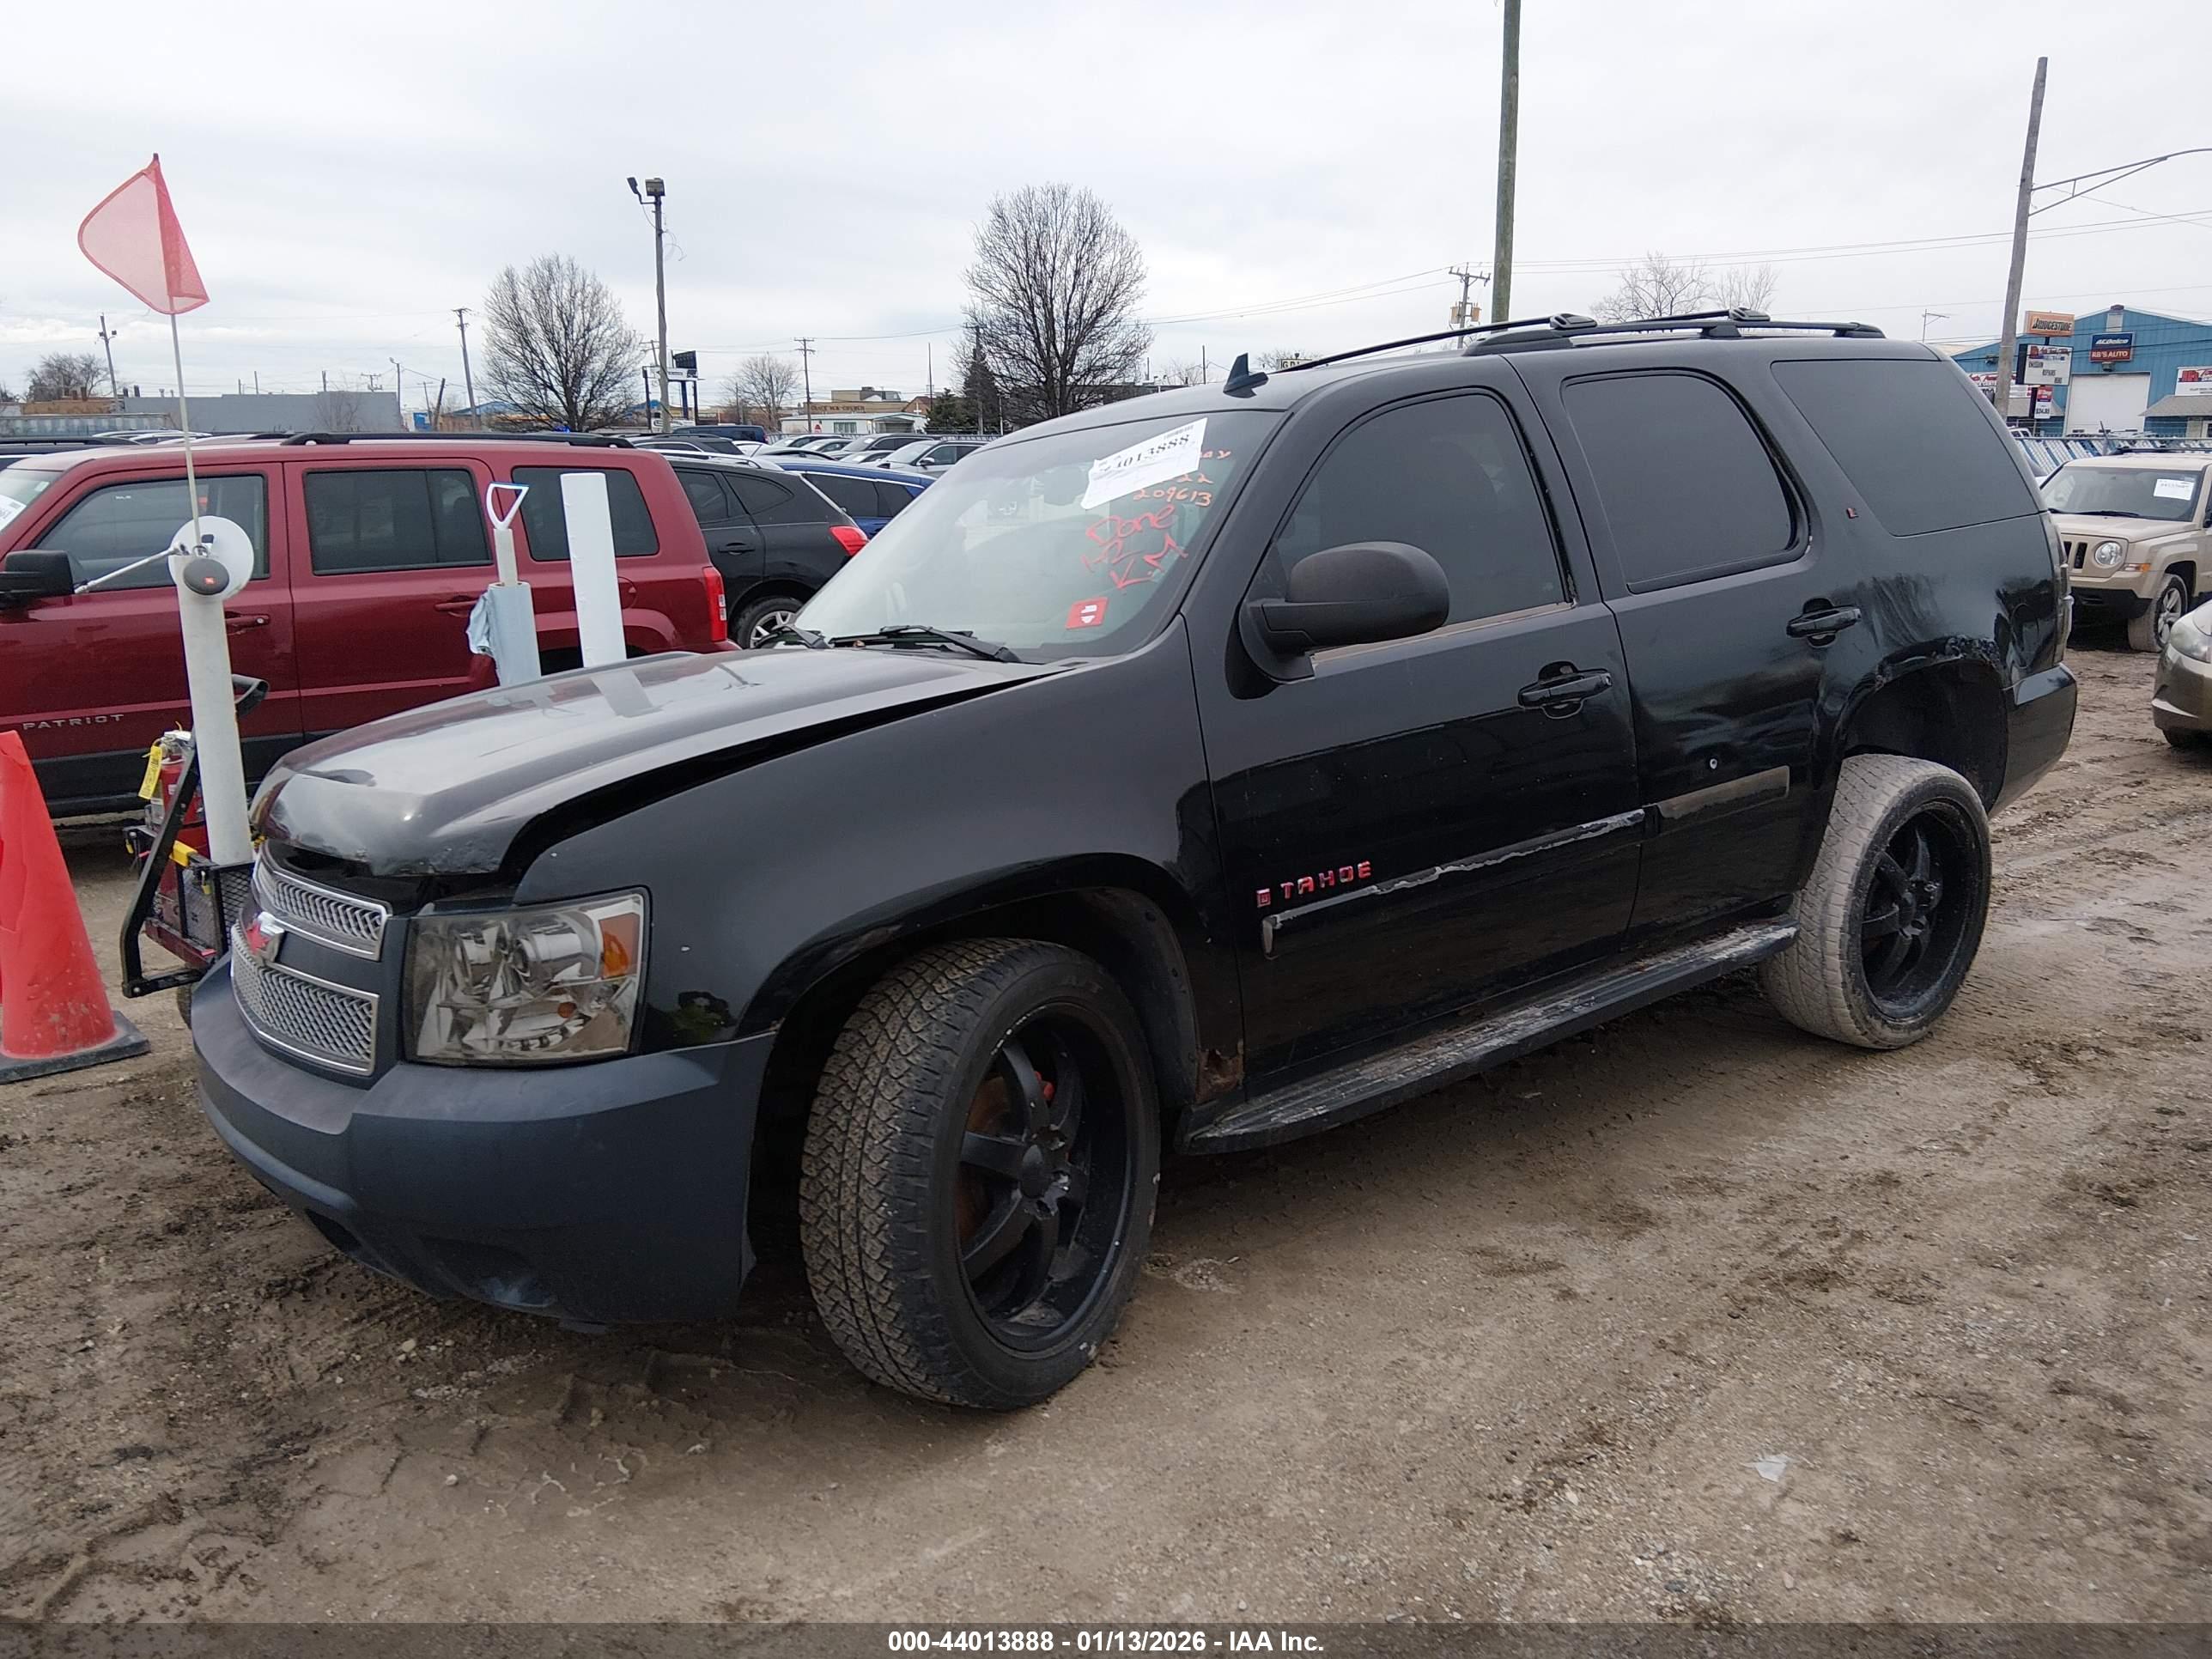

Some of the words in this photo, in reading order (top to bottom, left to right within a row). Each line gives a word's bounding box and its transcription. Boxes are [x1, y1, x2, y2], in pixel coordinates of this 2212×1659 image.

[2033, 319, 2071, 331] BRIDGESTONE
[1133, 487, 1212, 507] 209613
[22, 714, 125, 730] PATRIOT
[1279, 860, 1372, 900] TAHOE
